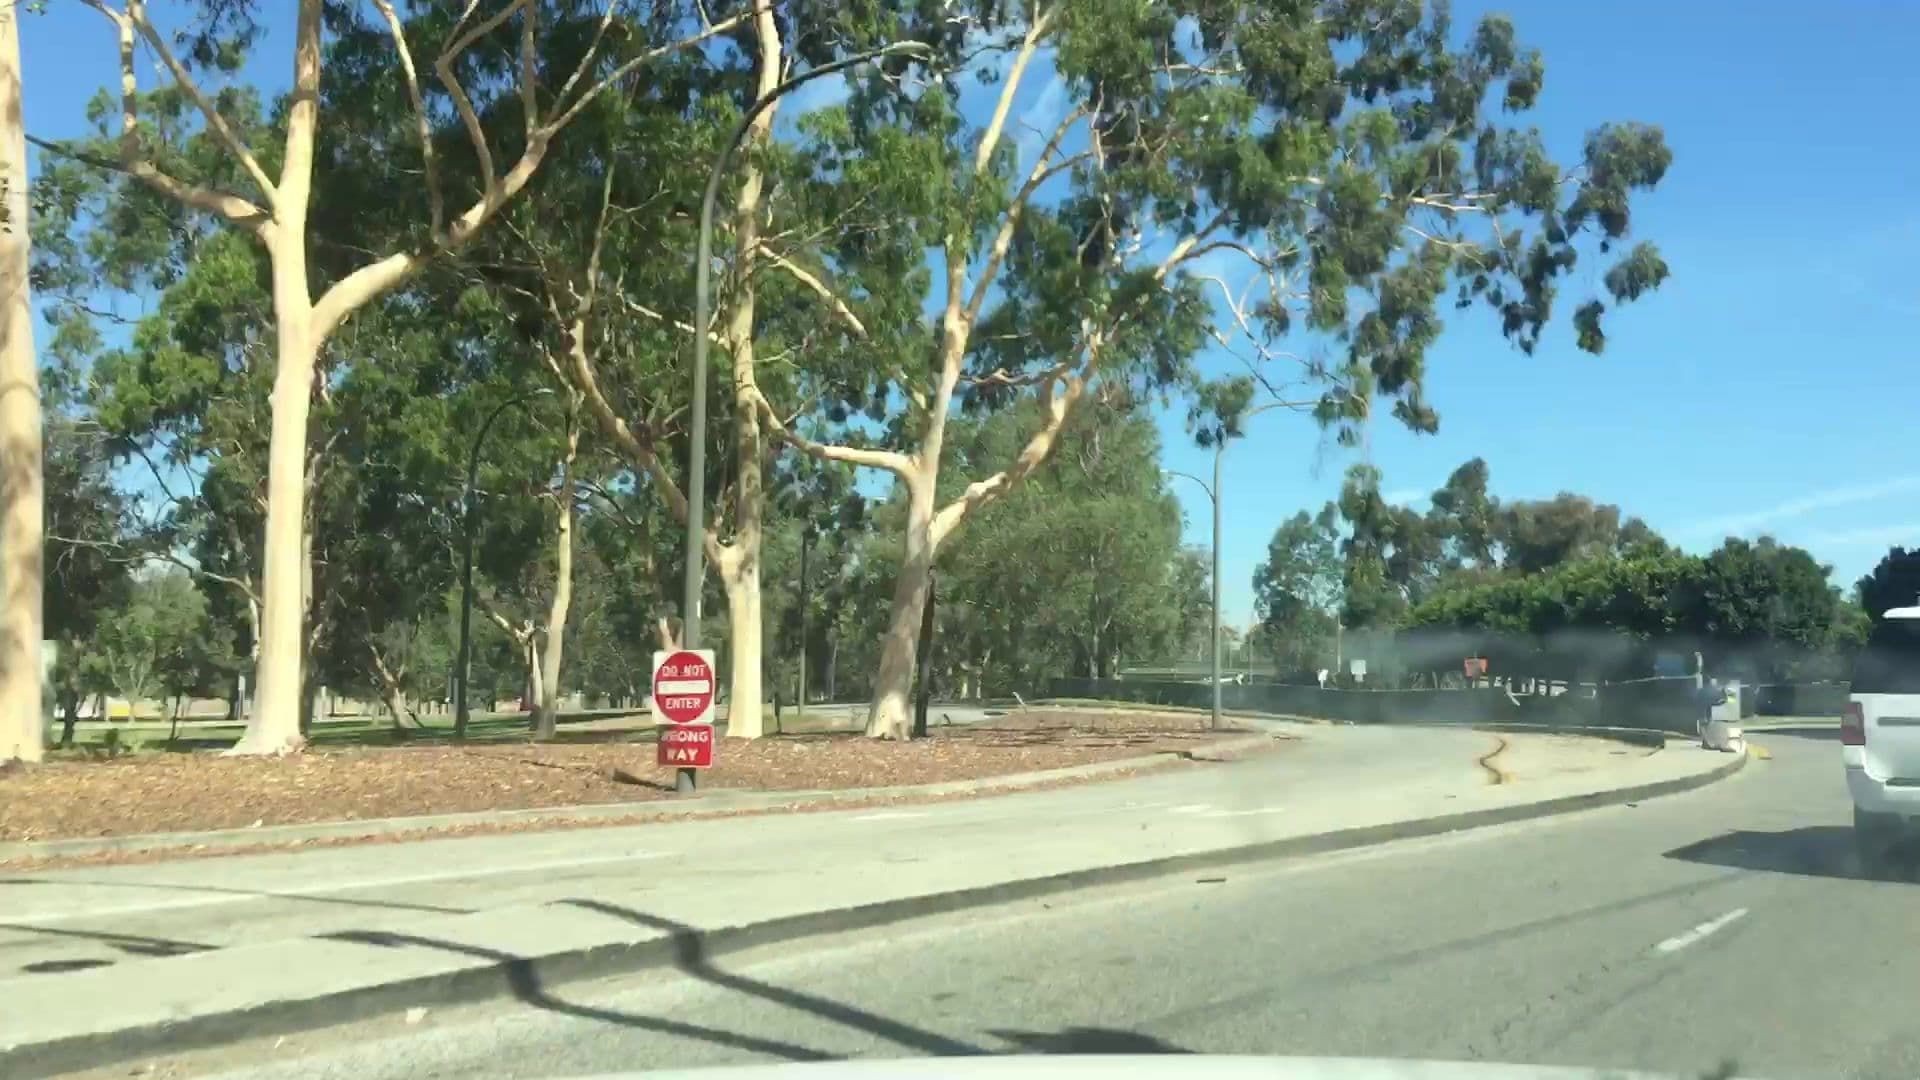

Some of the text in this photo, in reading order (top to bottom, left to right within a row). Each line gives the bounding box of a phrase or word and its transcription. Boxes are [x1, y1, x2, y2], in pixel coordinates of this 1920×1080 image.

[662, 665, 705, 677] DO NOT
[665, 698, 701, 709] ENTER
